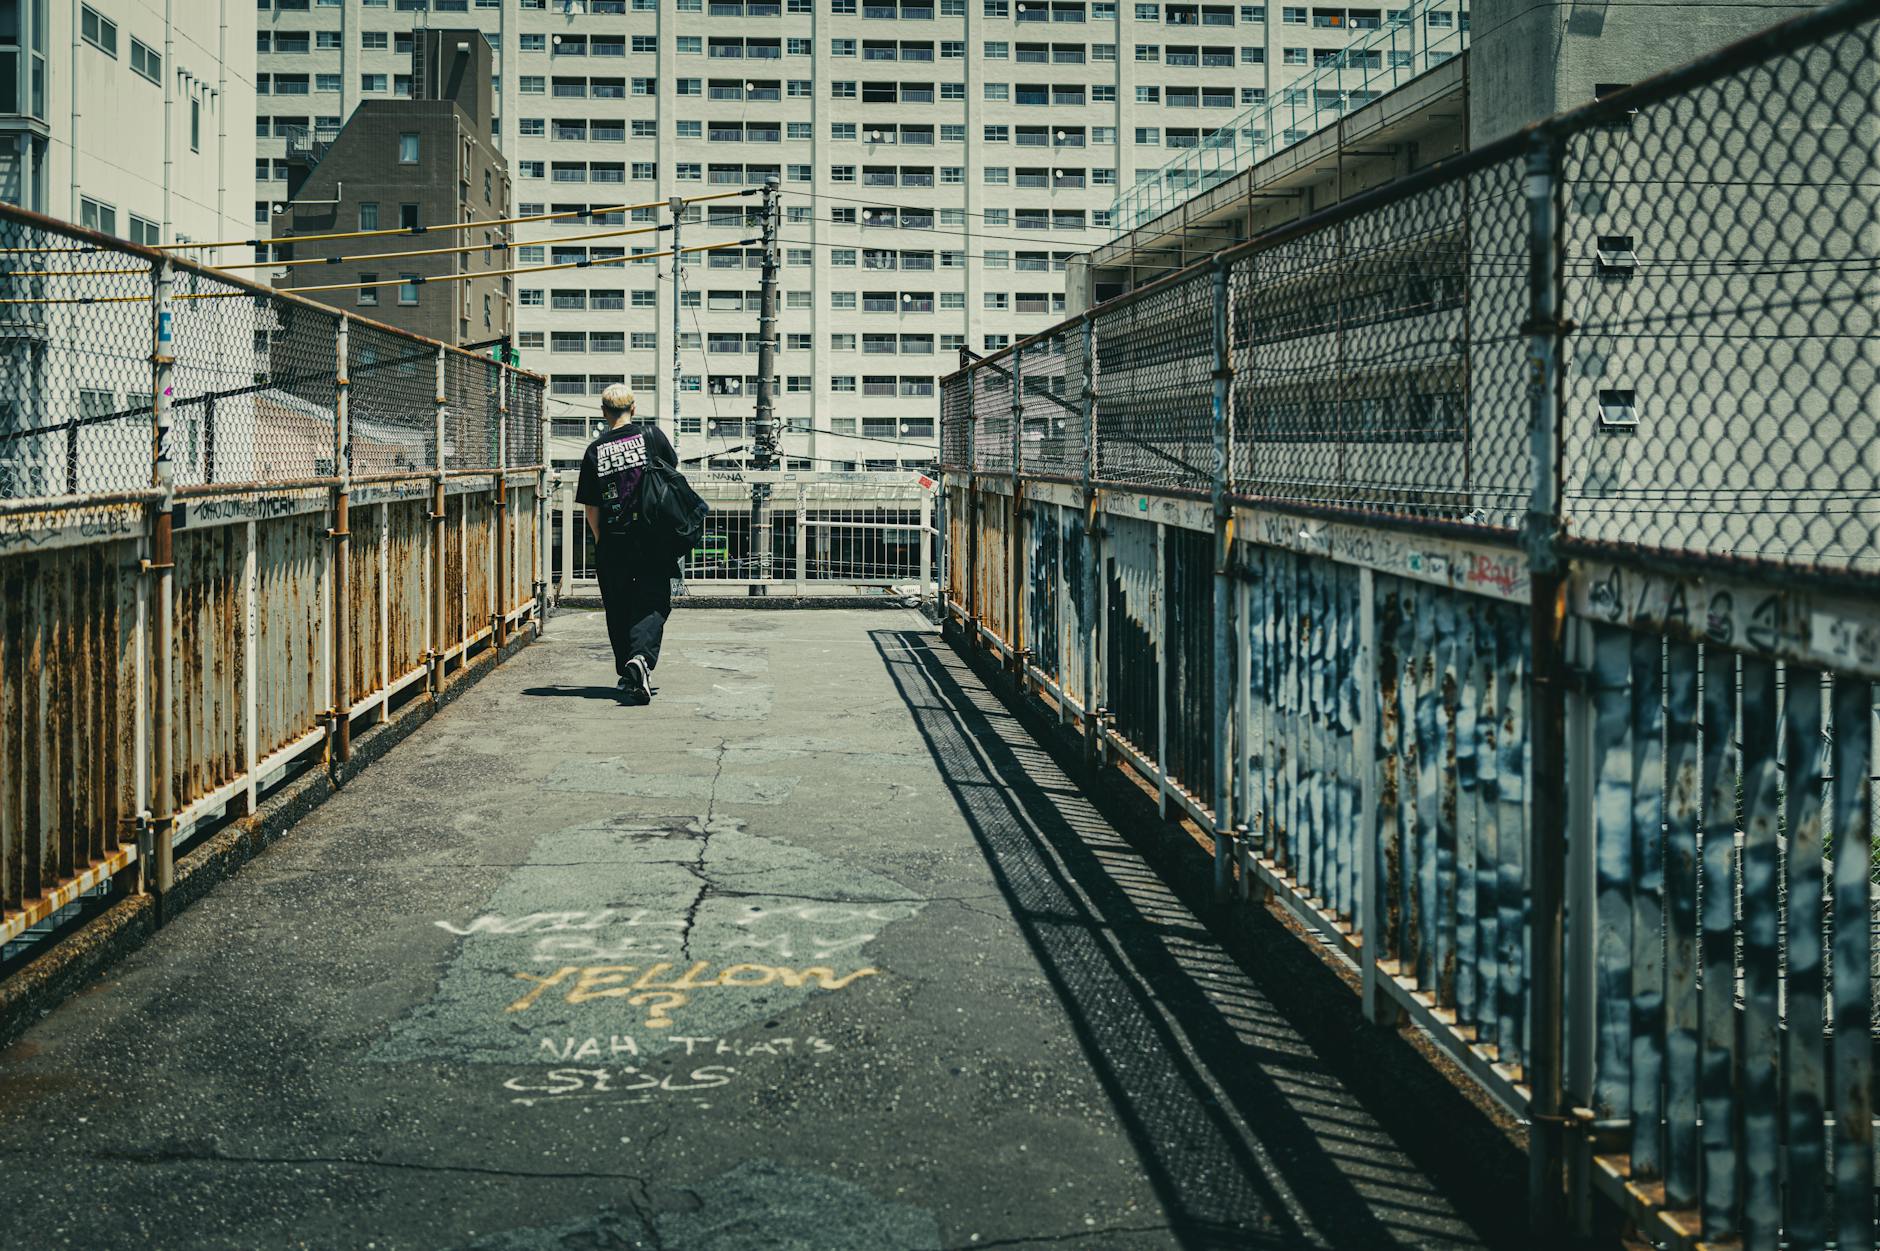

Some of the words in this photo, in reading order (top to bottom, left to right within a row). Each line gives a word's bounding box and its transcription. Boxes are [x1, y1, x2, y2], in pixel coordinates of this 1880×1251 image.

[505, 960, 881, 1013] YELLOW
[628, 991, 687, 1028] ?
[540, 1036, 638, 1060] NAH
[668, 1035, 834, 1056] THAT'S
